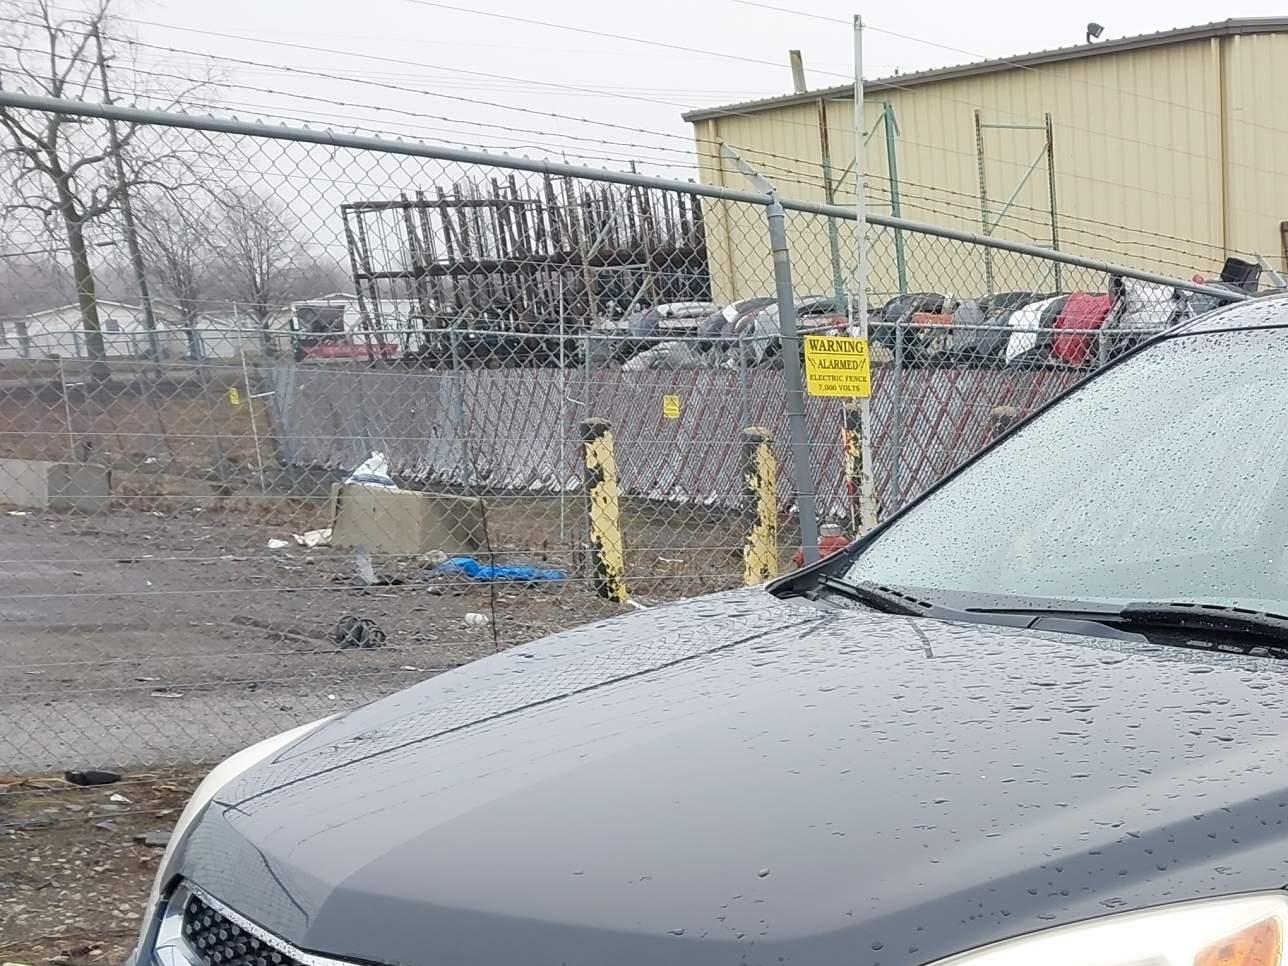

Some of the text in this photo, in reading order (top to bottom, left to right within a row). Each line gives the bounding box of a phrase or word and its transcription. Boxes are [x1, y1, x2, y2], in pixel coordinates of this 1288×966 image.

[809, 339, 864, 353] WARNING
[818, 359, 859, 370] ALARMED
[809, 374, 867, 383] ELECTRIC FENCE
